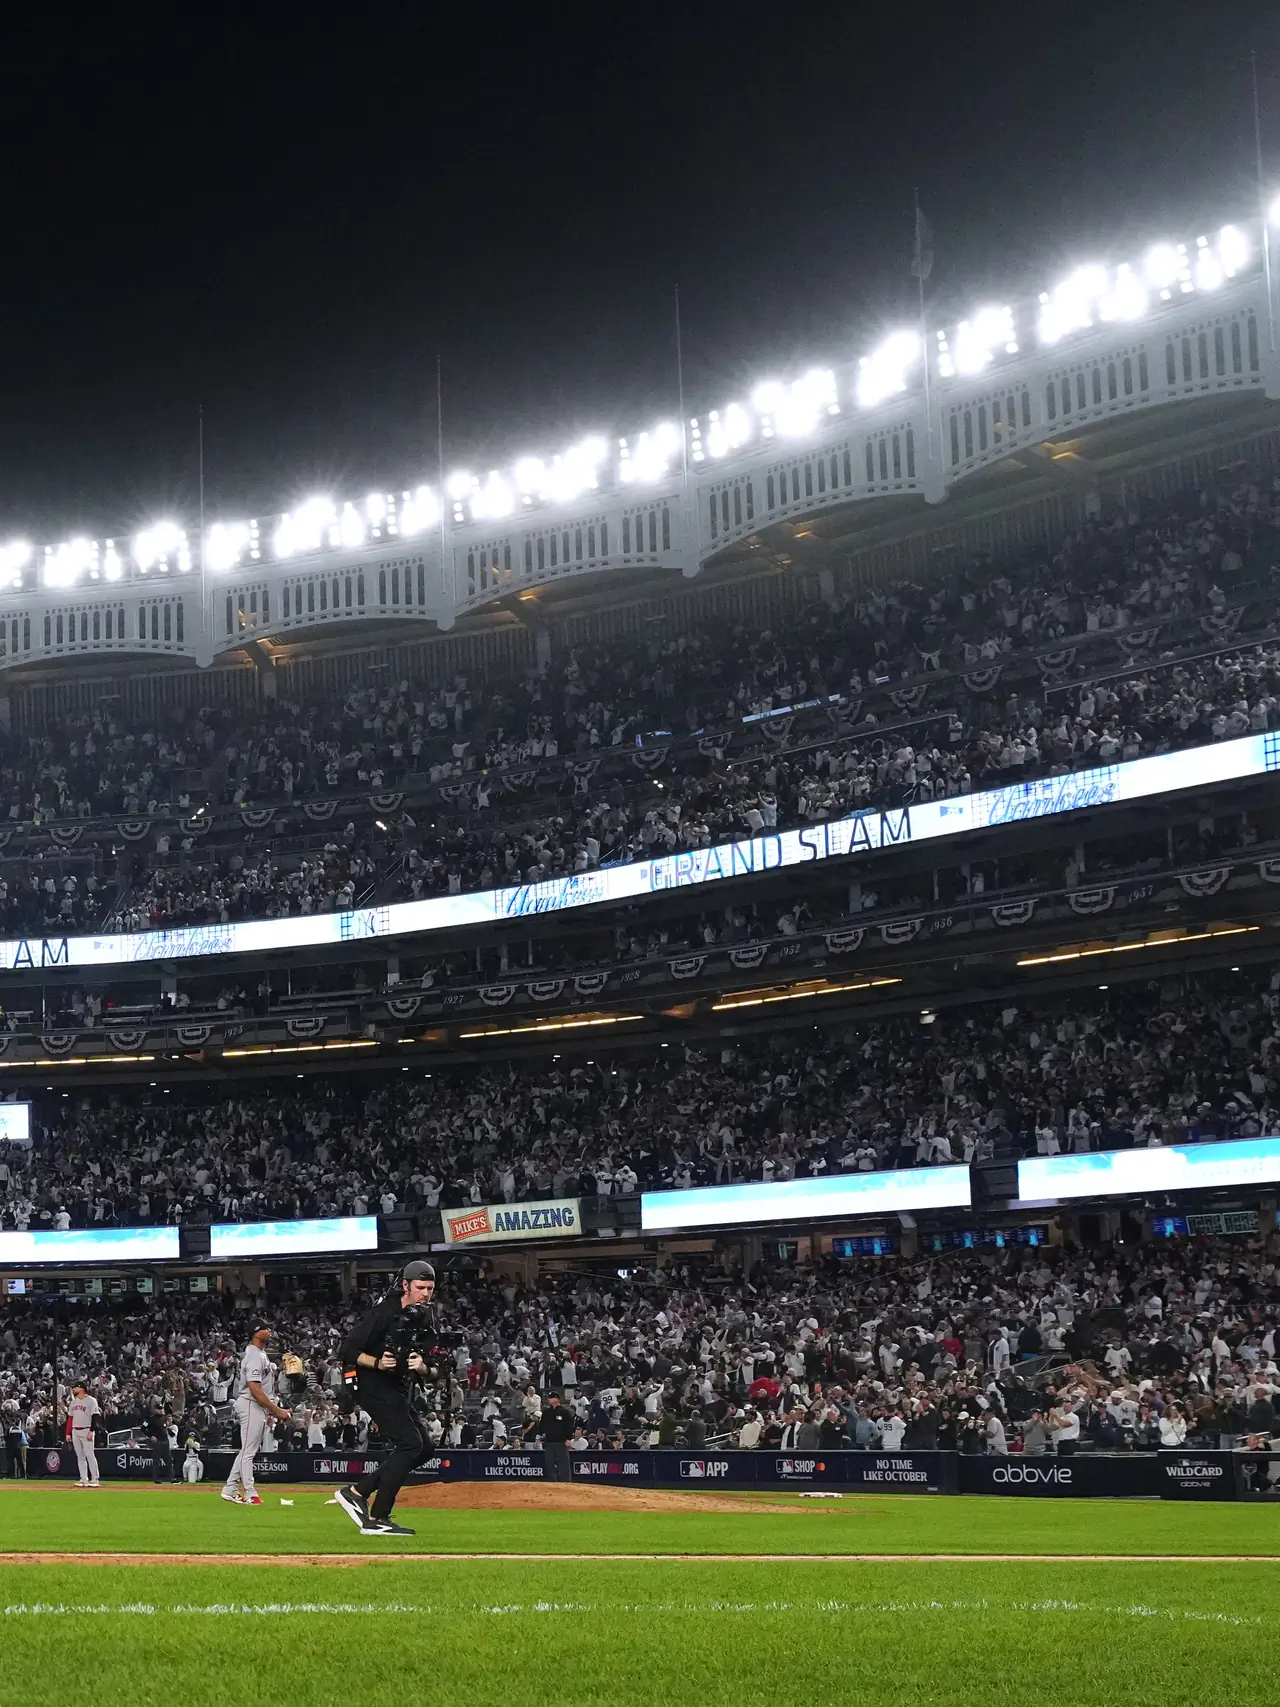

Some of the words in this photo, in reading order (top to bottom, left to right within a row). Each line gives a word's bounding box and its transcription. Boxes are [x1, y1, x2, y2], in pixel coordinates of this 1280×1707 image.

[650, 834, 782, 892] GRAND
[799, 809, 911, 863] SLAM
[455, 1216, 486, 1235] MIKE'S
[495, 1207, 574, 1231] AMAZING
[252, 1462, 288, 1471] STSEASON
[497, 1457, 509, 1466] NO
[510, 1457, 530, 1466] TIME
[794, 1460, 815, 1472] SHOP
[876, 1459, 889, 1469] NO
[891, 1459, 913, 1470] TIME
[485, 1467, 504, 1476] LIKE
[505, 1467, 543, 1476] OCTOBER
[706, 1462, 729, 1476] APP
[993, 1464, 1072, 1483] abbvie
[863, 1470, 884, 1481] LIKE
[885, 1471, 927, 1482] OCTOBER
